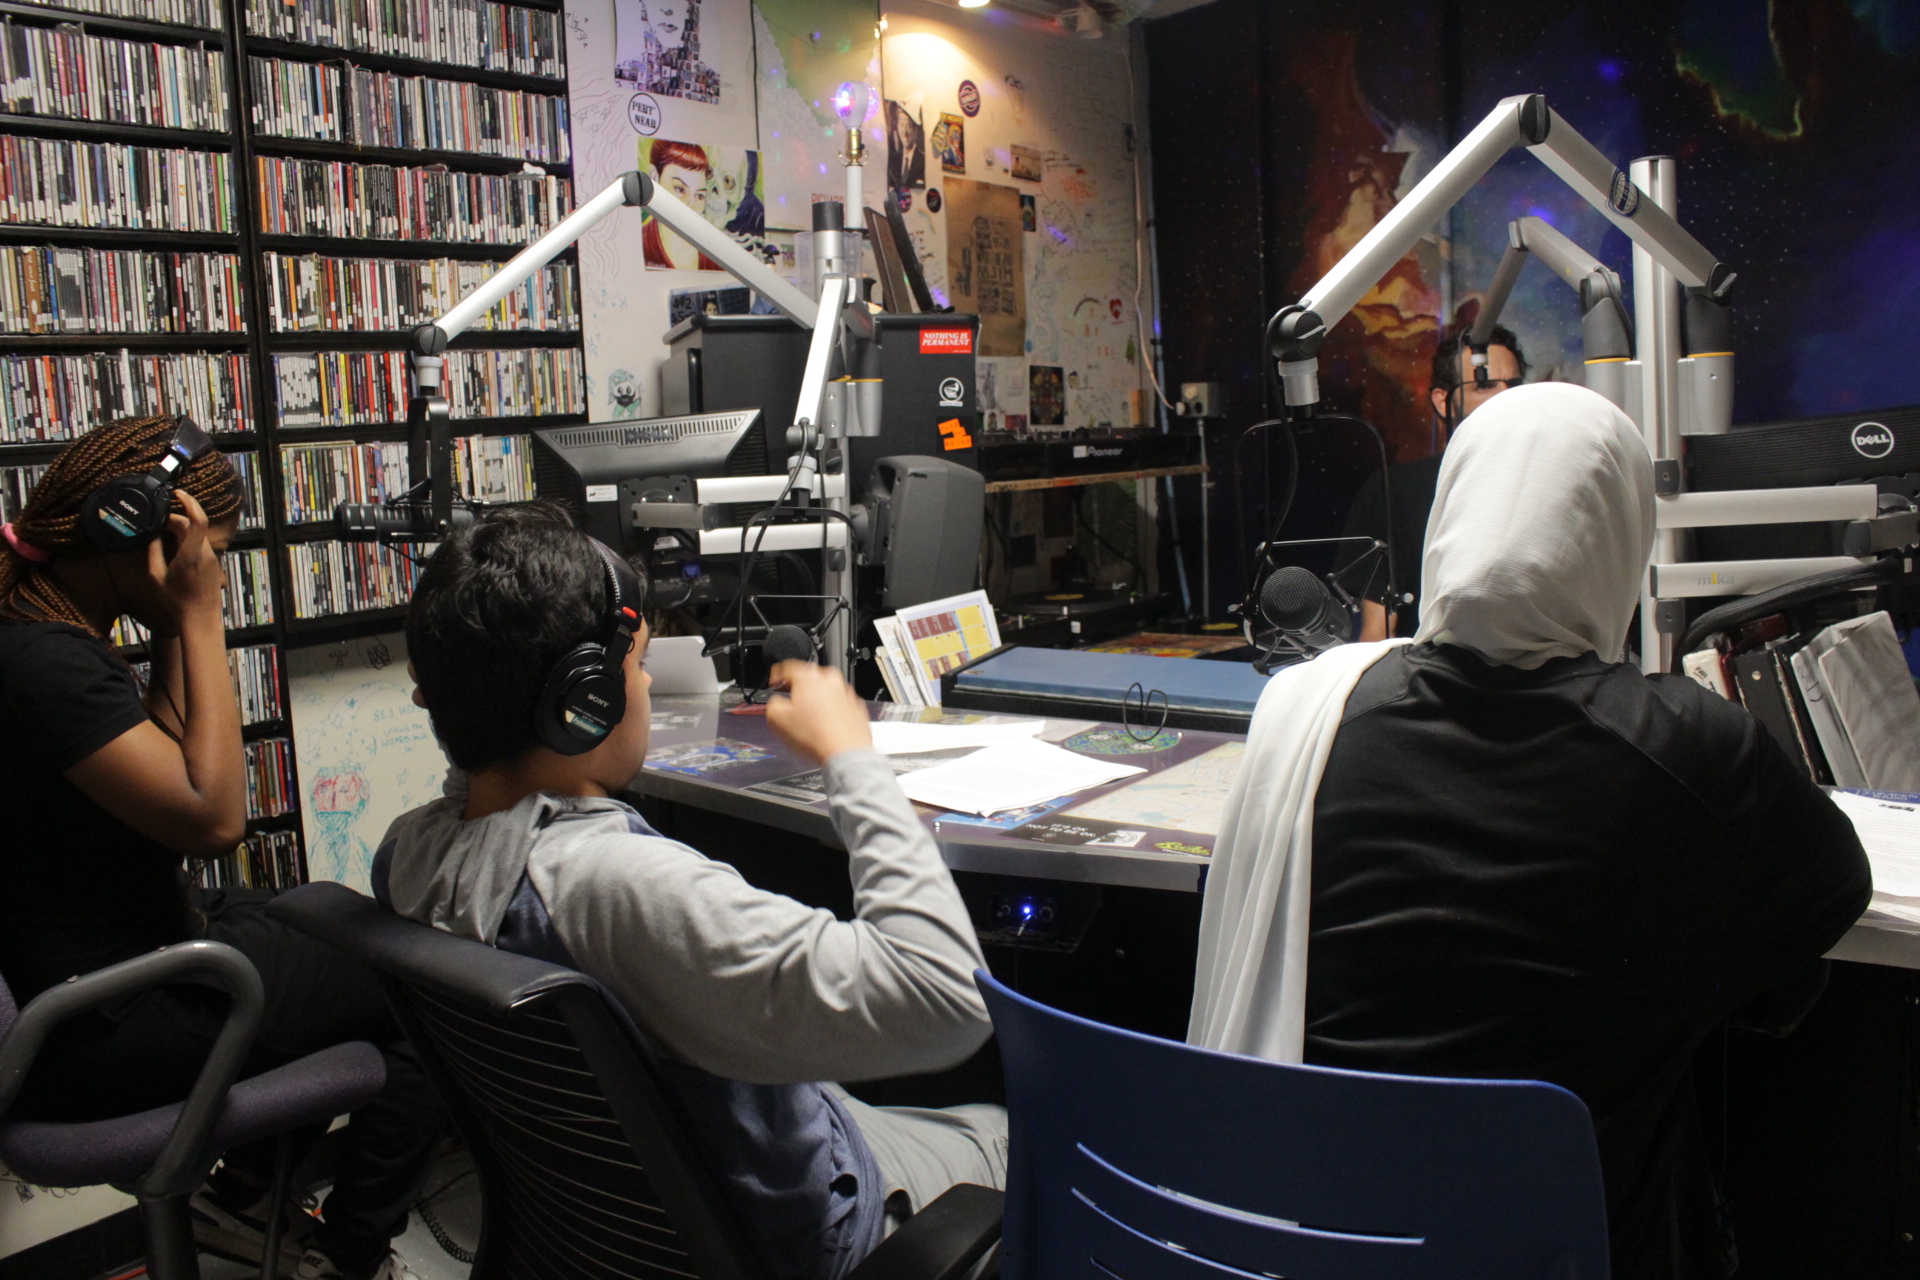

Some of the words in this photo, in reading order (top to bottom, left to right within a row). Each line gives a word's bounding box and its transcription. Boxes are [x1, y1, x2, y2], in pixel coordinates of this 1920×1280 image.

[632, 100, 656, 116] PERT
[634, 114, 657, 129] NEAR
[924, 331, 958, 340] NOTHING
[959, 331, 969, 339] IS
[922, 338, 970, 347] PERMANENT
[1856, 433, 1890, 446] DELL
[1088, 445, 1123, 457] Pioneer
[119, 500, 140, 515] SONY
[1697, 572, 1735, 585] mika
[587, 693, 610, 708] SONY
